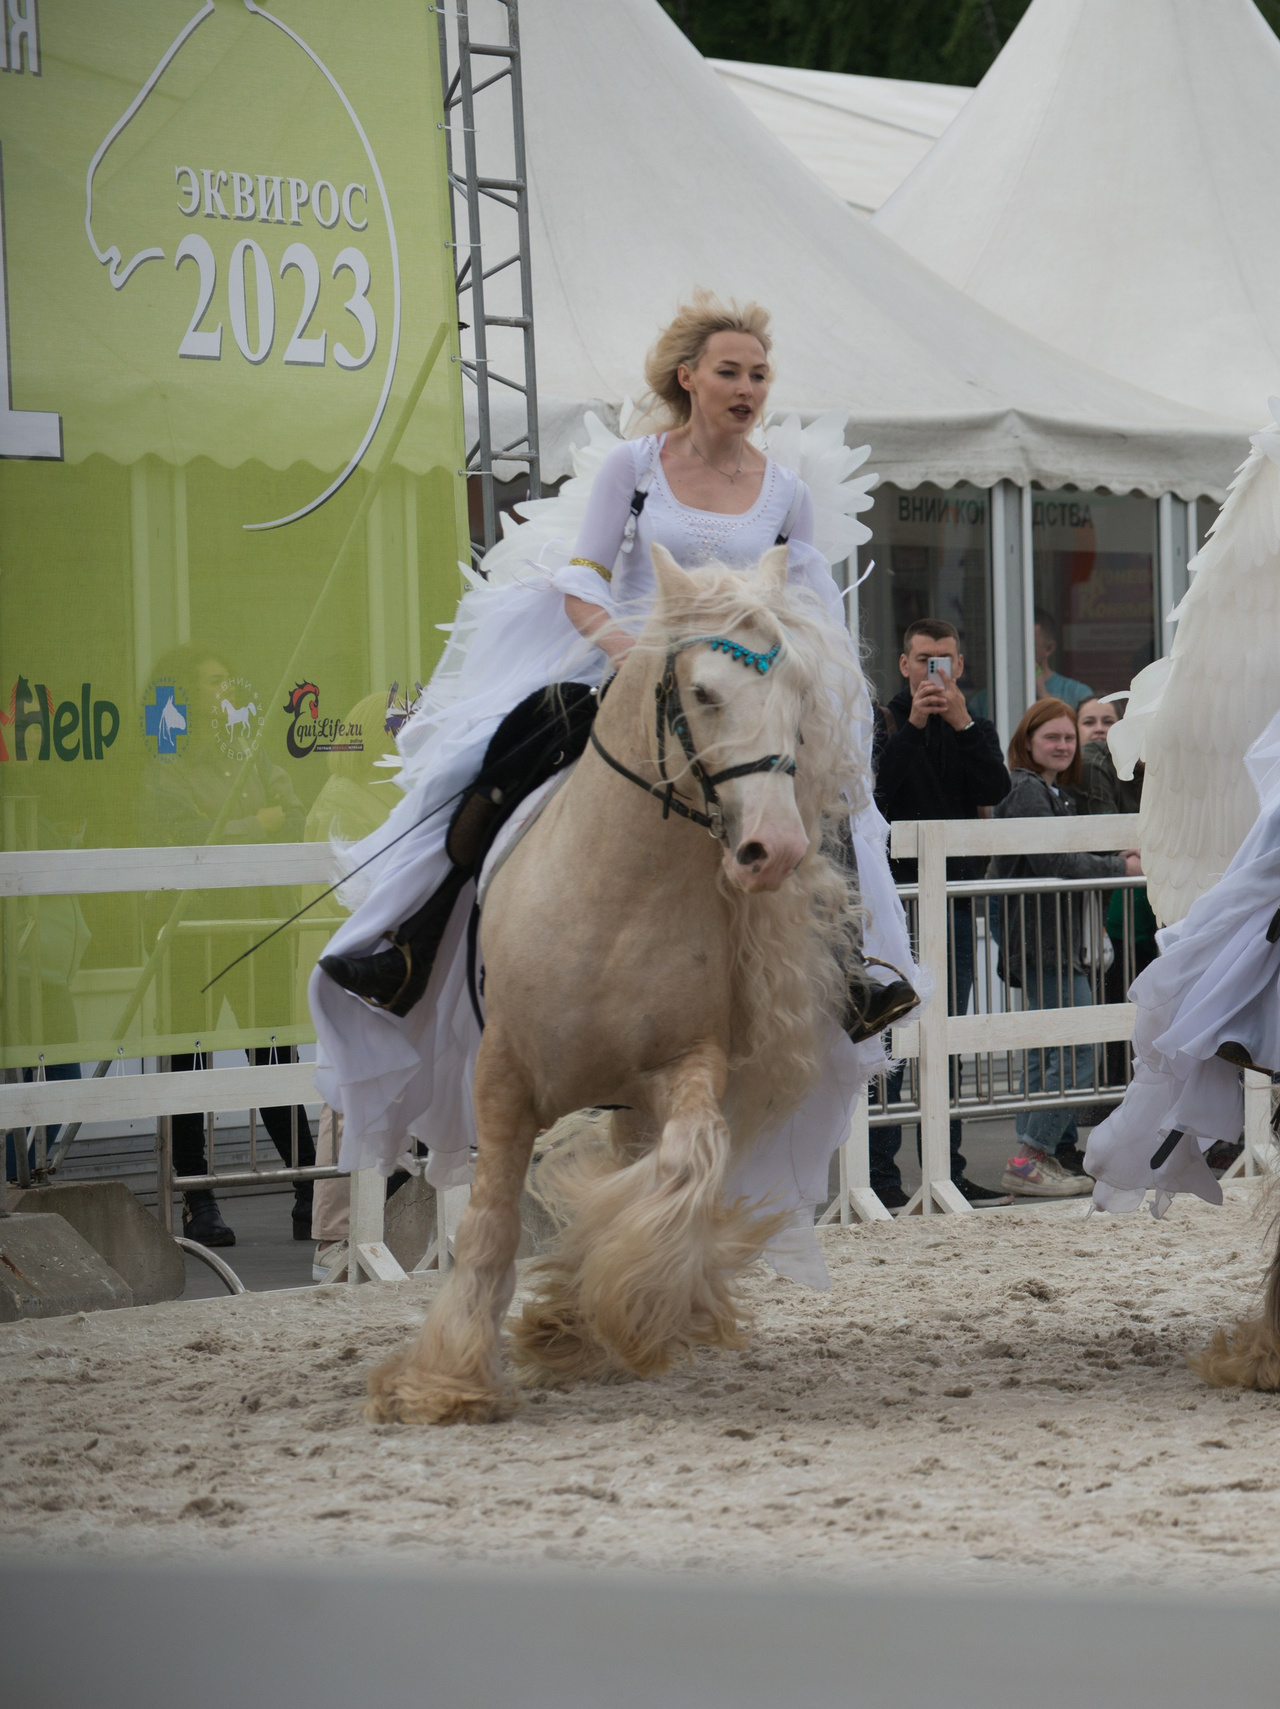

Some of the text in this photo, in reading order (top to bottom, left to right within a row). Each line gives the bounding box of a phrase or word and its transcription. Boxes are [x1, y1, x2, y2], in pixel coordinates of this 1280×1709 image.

[174, 165, 369, 230] ЭКВИРОС
[174, 233, 377, 369] 2023
[898, 495, 949, 523] ВНИИ
[220, 677, 252, 692] ВНИИ
[13, 674, 121, 762] Help
